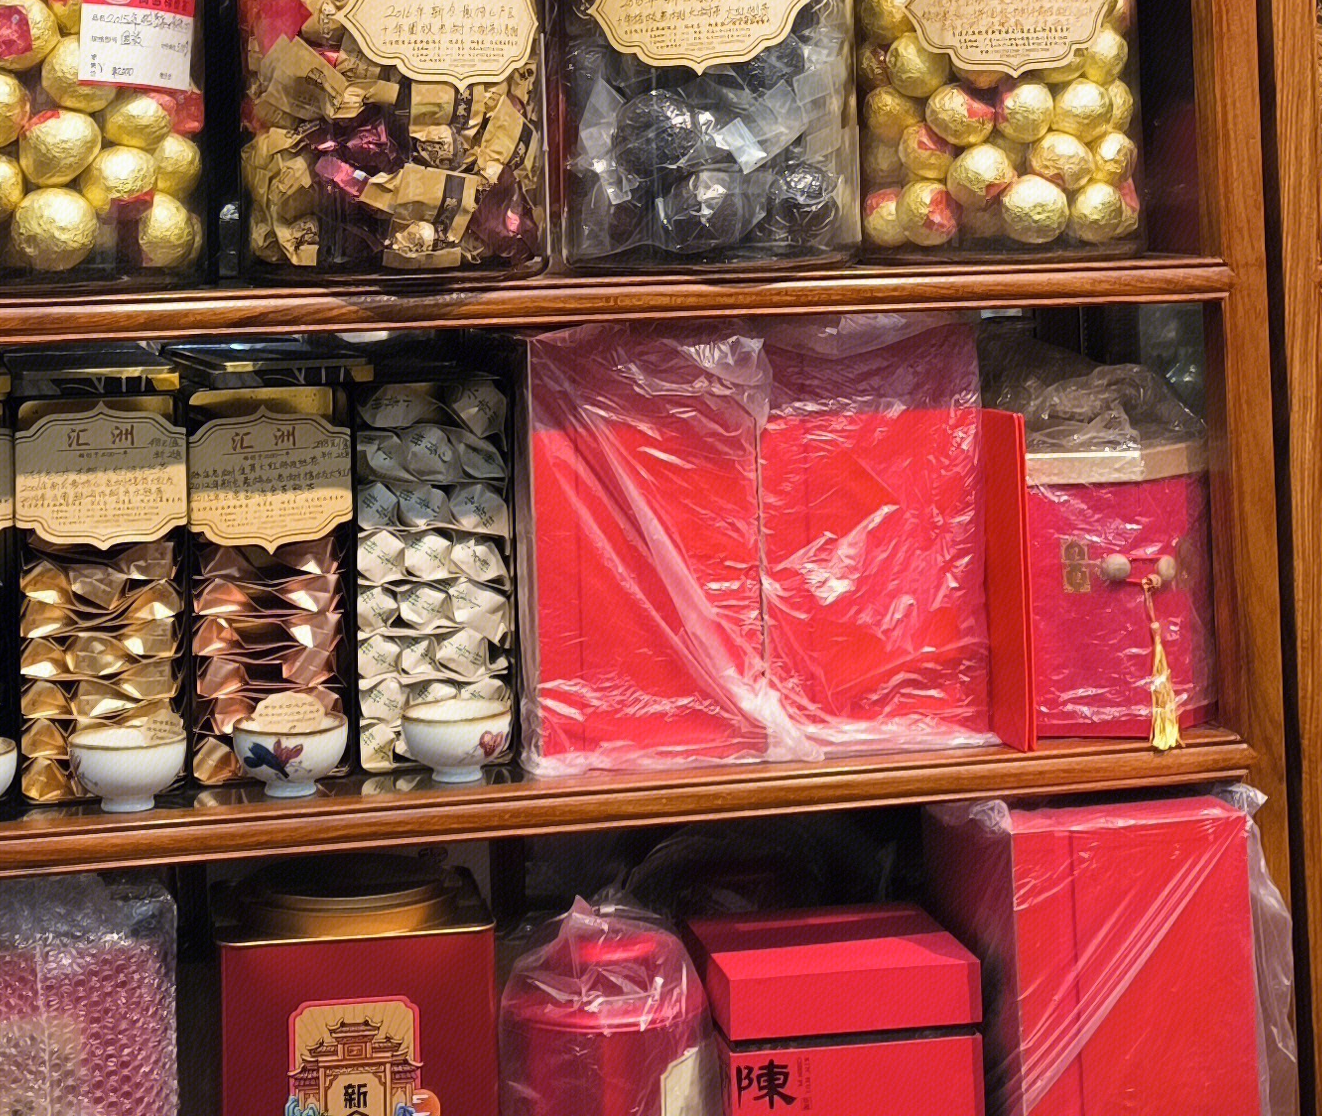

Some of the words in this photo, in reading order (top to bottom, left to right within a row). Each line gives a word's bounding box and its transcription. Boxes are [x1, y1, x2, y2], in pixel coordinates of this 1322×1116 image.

[67, 424, 135, 448] 汇洲
[231, 426, 296, 451] 汇洲
[736, 1059, 796, 1109] 陳
